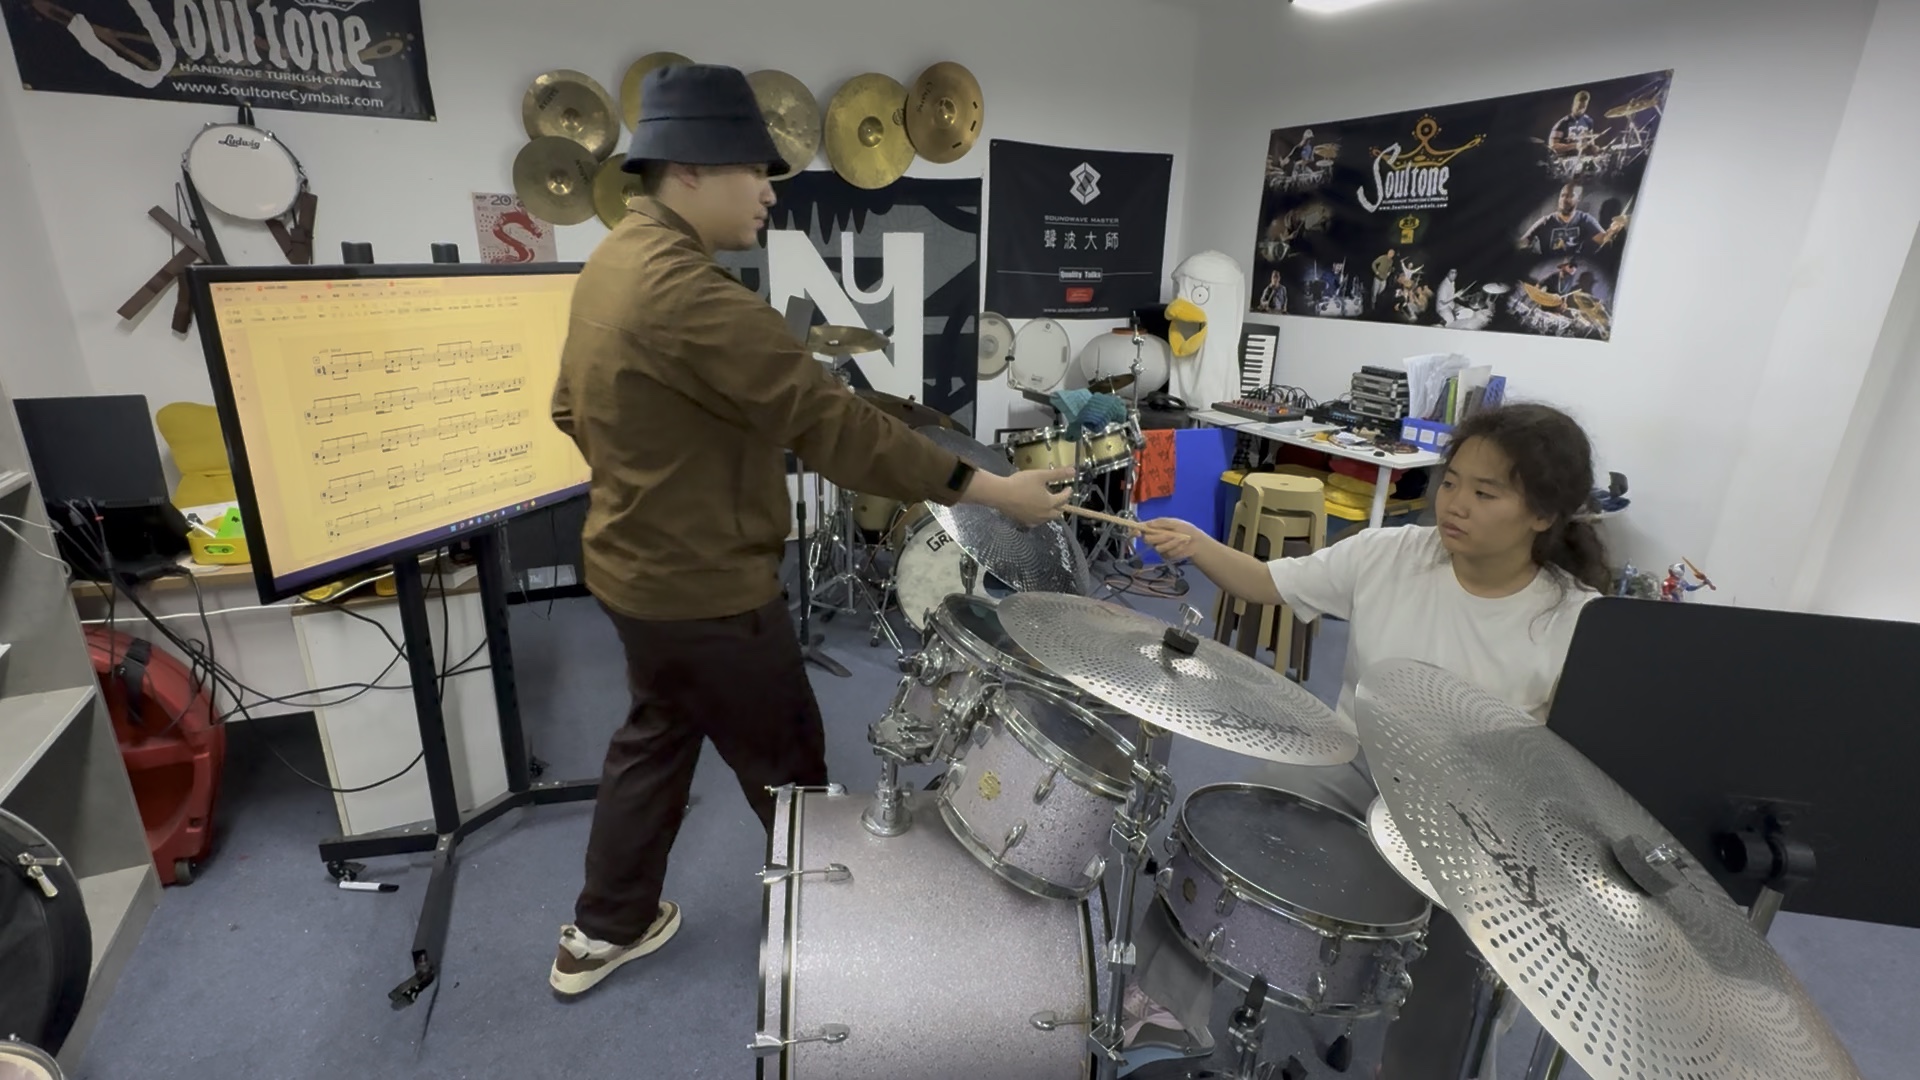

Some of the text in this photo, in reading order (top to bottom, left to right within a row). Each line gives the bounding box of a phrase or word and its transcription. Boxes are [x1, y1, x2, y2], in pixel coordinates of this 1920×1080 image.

[179, 63, 382, 89] HANDMADE TURKISH CYMBALS
[172, 81, 384, 108] www.SoultoneCymbals.com
[218, 134, 260, 149] Ludwig
[1356, 142, 1450, 213] Soultone
[1044, 215, 1089, 223] SOUNDWAVE
[1044, 229, 1119, 250] 聲波大師
